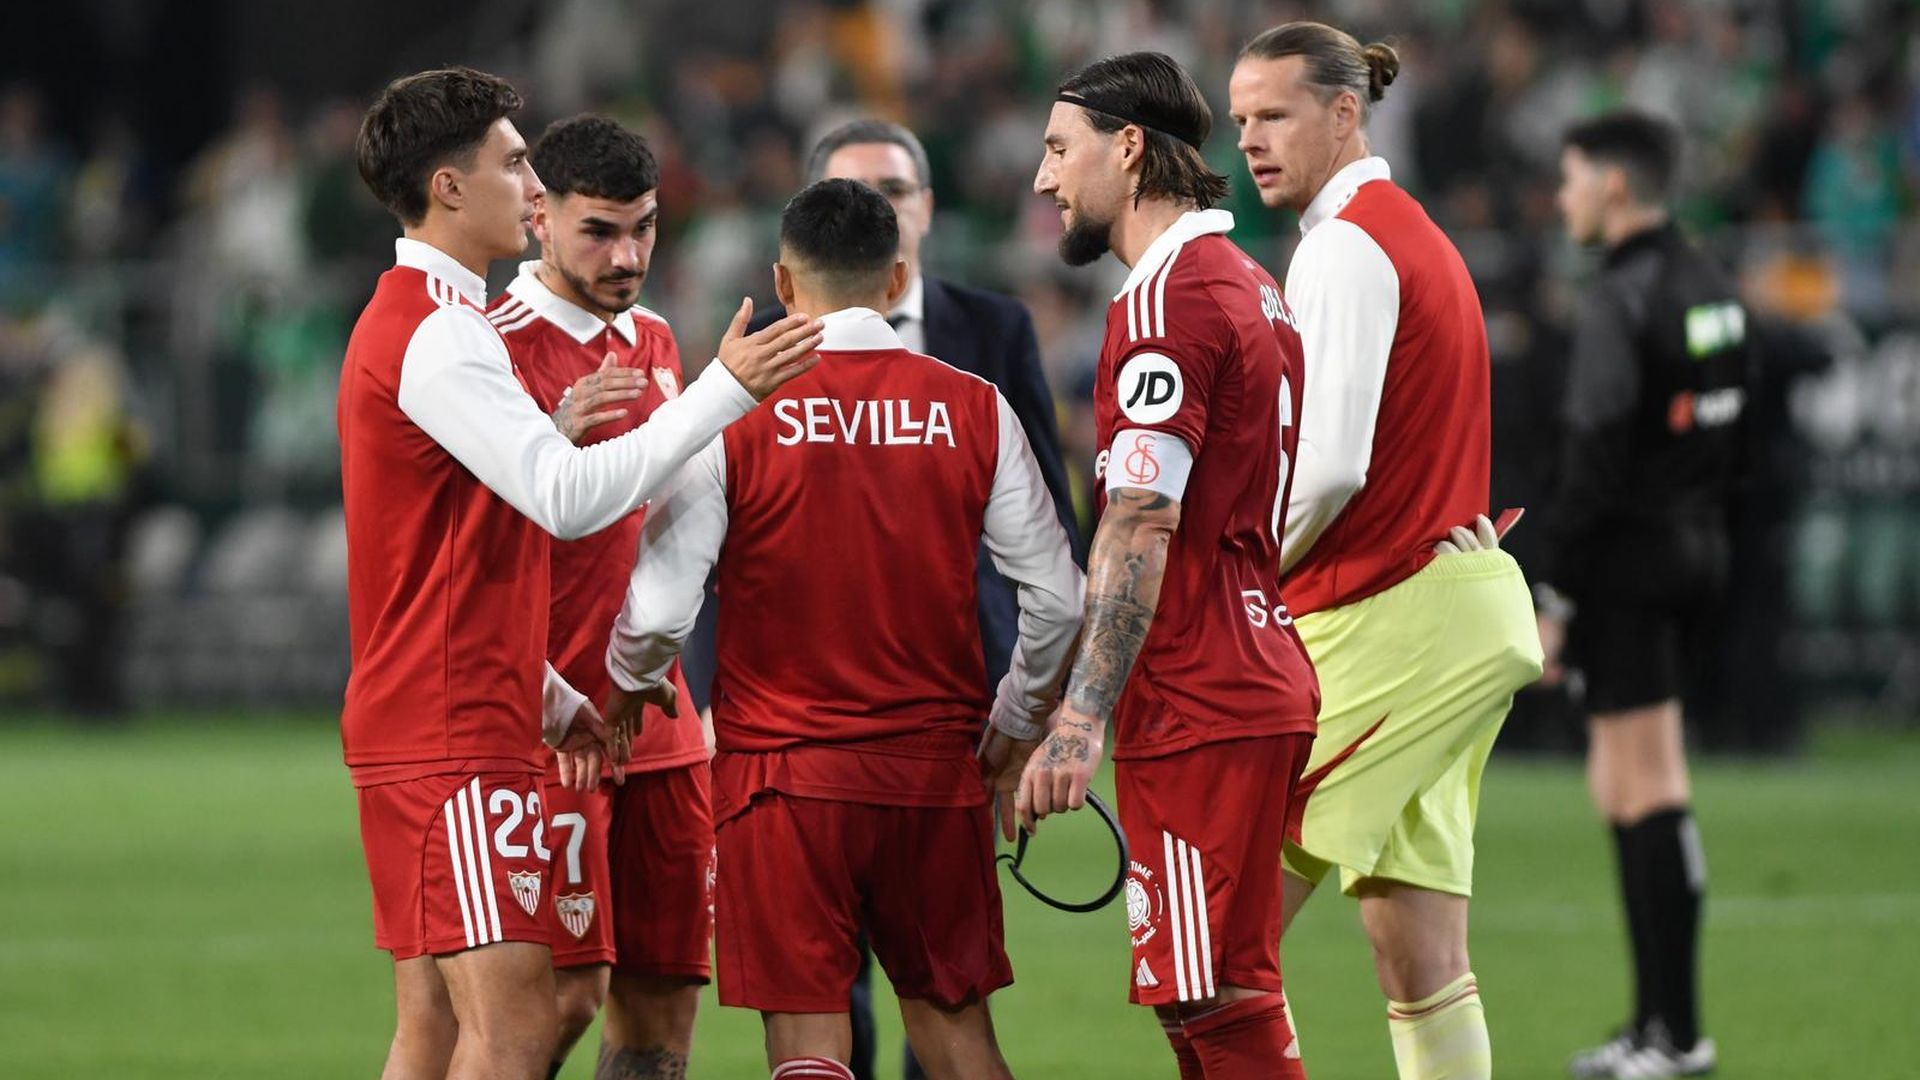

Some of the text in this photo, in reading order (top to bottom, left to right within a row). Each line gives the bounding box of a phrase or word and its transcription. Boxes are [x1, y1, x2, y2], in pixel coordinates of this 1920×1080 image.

[1126, 371, 1176, 409] JD
[774, 397, 956, 448] SEVILLA
[551, 812, 587, 884] 7
[1130, 860, 1153, 880] TIME
